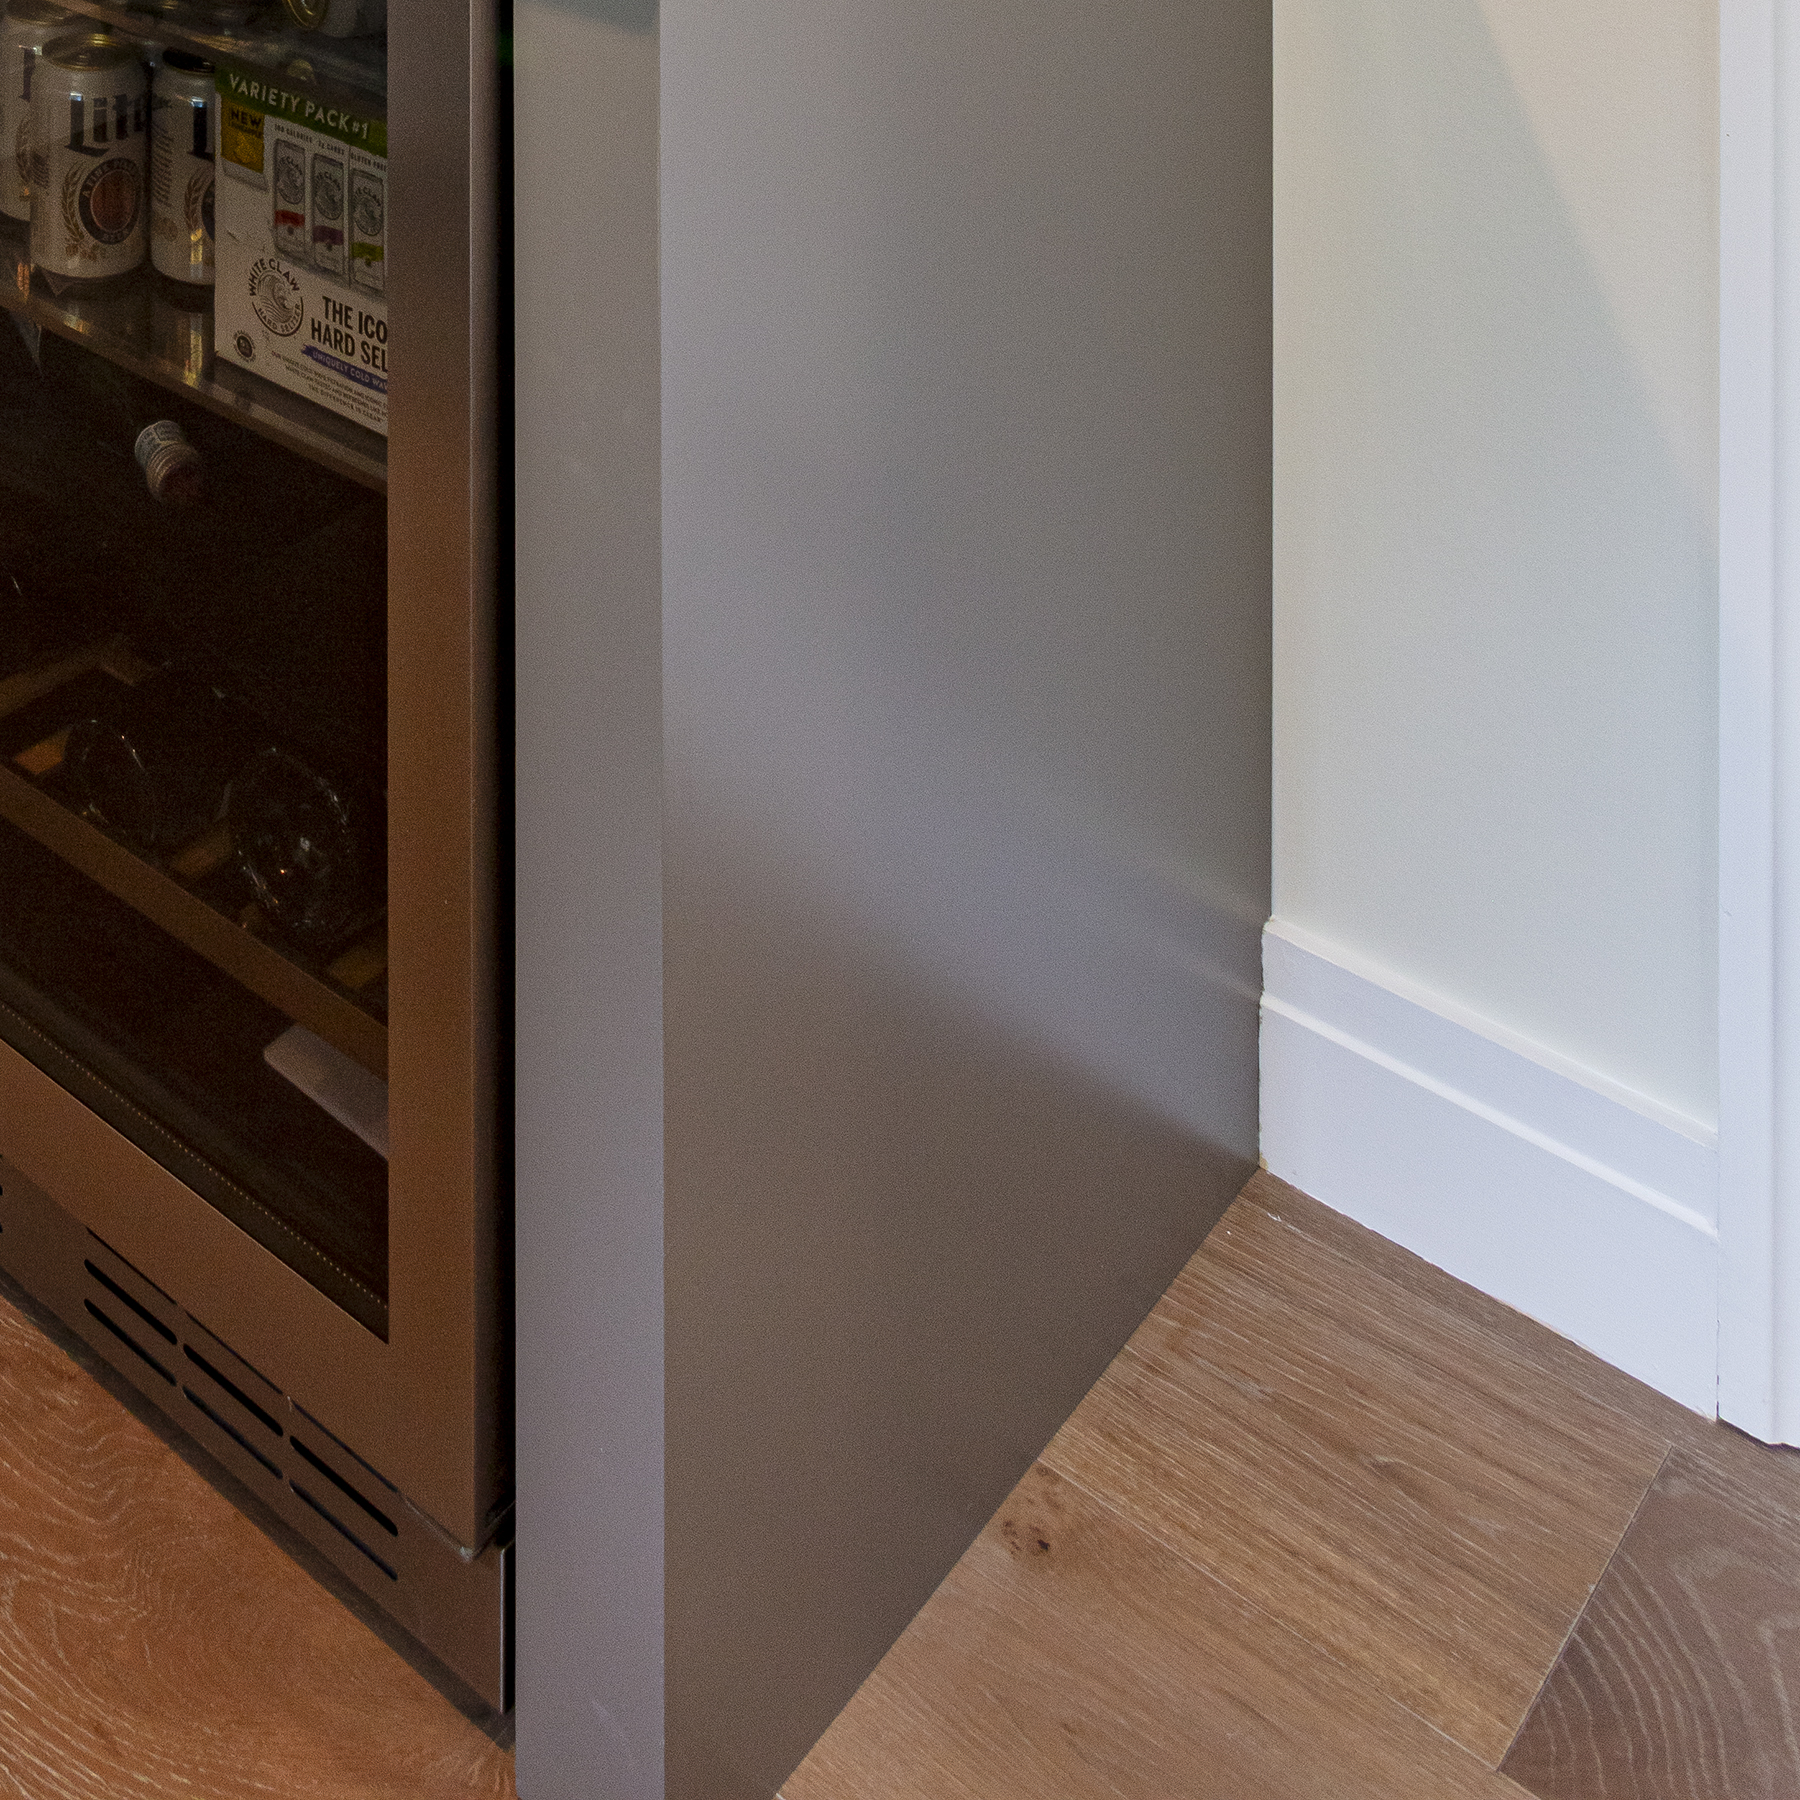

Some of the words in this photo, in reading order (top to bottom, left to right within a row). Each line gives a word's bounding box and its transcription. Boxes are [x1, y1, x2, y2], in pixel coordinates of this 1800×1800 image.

[228, 73, 301, 113] VARIETY
[304, 100, 350, 133] PACK
[231, 108, 263, 129] NEW
[248, 258, 269, 297] WHITE
[267, 257, 301, 293] CLAW
[310, 317, 357, 358] HARD
[321, 295, 354, 331] THE
[357, 310, 389, 345] ICO
[311, 350, 350, 374] UNIQUELY
[349, 366, 371, 384] COLD
